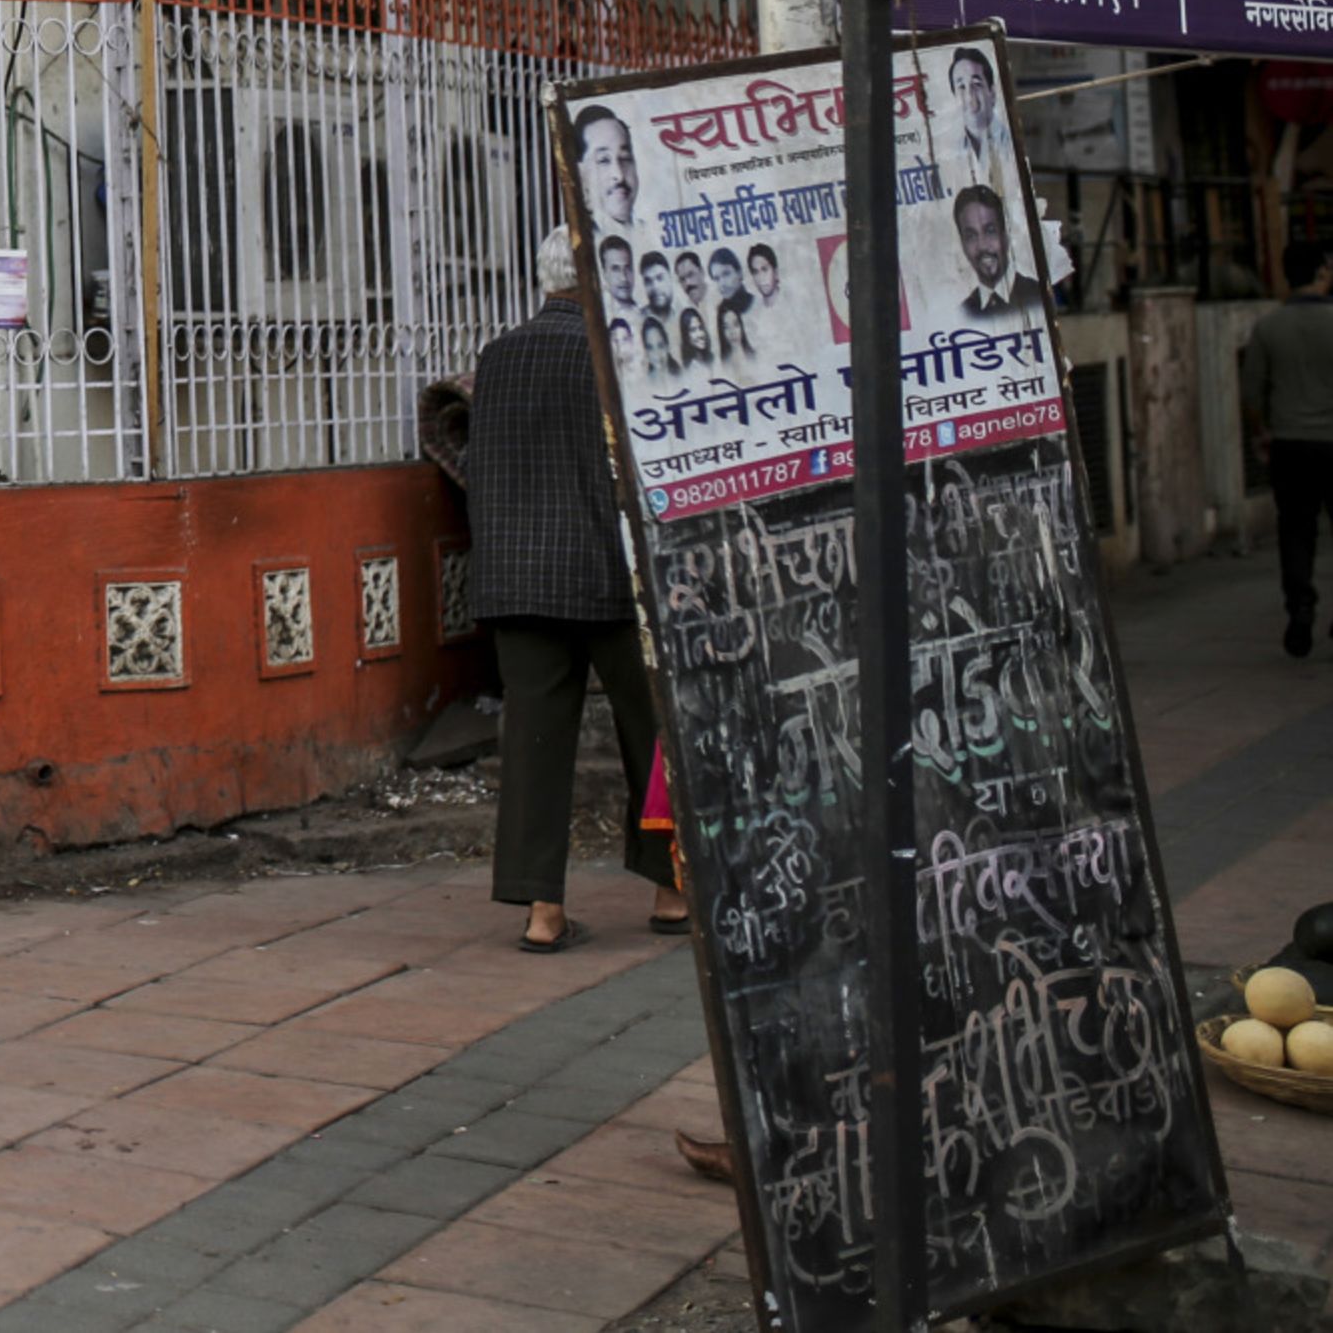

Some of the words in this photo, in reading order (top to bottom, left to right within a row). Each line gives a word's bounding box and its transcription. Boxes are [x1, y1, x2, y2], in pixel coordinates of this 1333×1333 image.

[658, 192, 718, 248] आपले
[718, 183, 778, 238] हार्दिक
[779, 182, 841, 225] स्वागत
[641, 440, 745, 479] उपाध्यक्ष
[777, 413, 854, 448] स्वाभि
[904, 387, 988, 422] चित्रपट
[996, 375, 1046, 403] सेना
[672, 459, 802, 509] 9820111787
[958, 404, 1062, 440] agnelo78
